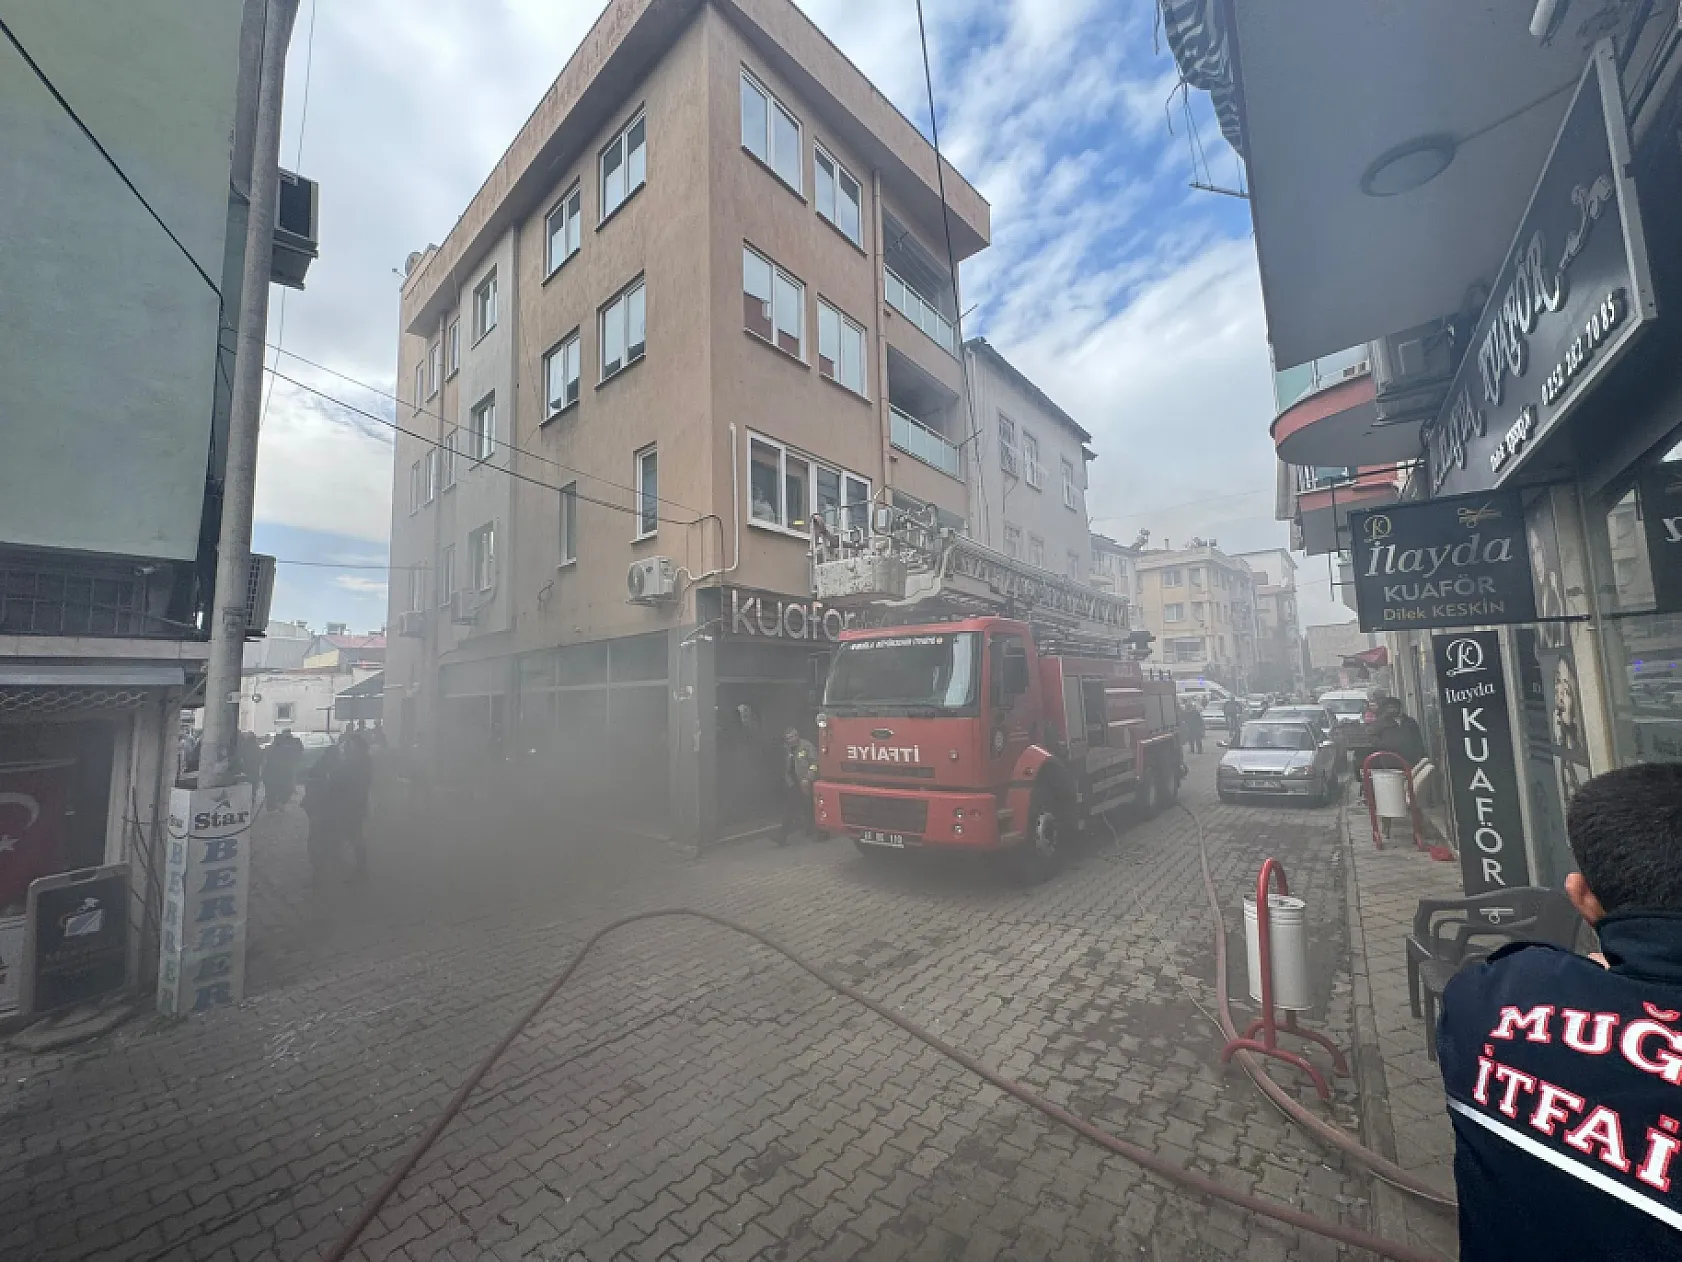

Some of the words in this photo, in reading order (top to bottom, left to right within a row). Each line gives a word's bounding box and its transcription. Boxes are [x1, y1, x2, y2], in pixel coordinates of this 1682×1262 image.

[1600, 292, 1615, 331] 85
[1364, 533, 1513, 578] İlayda
[1384, 573, 1497, 602] KUAFÖR
[1383, 606, 1427, 621] Dilek
[1433, 598, 1504, 617] KESKİN
[1462, 707, 1506, 886] KUAFÖR
[195, 810, 249, 830] Star
[190, 838, 238, 1012] BERBER
